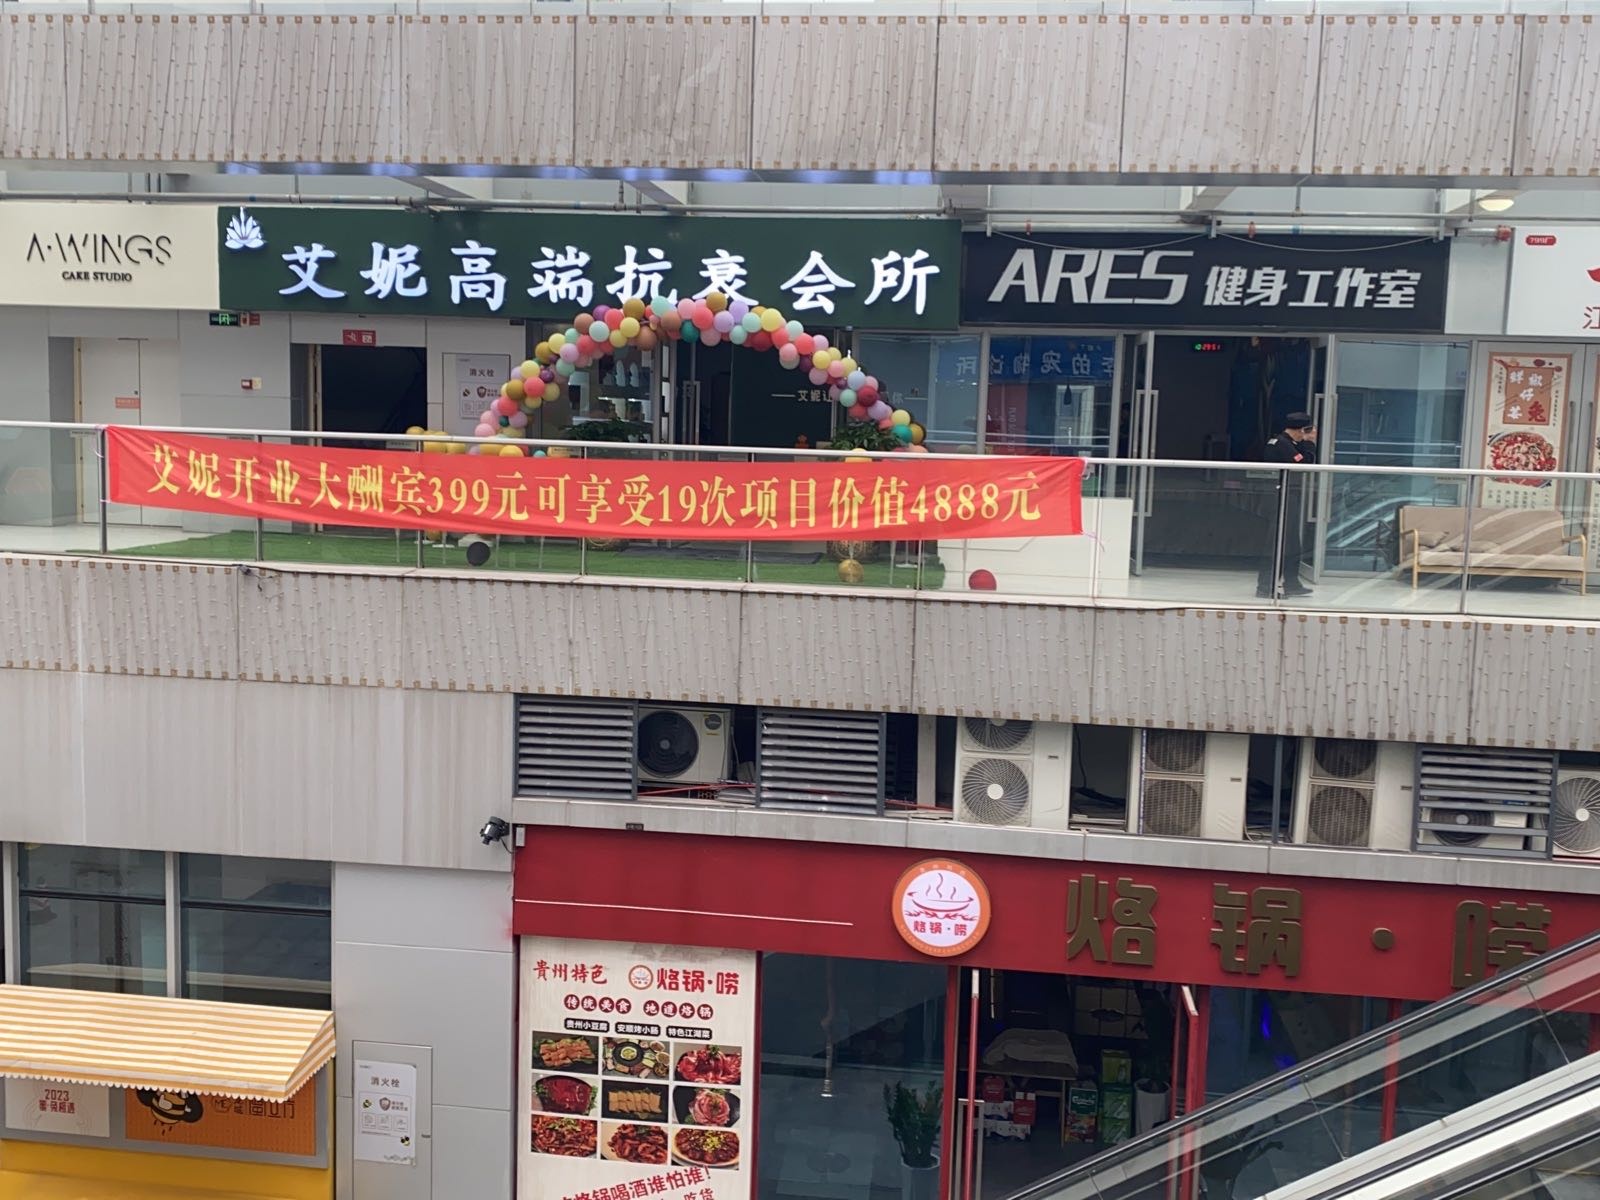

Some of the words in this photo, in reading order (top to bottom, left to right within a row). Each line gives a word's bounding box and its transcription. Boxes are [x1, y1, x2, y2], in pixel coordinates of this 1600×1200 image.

[62, 271, 90, 281] CAKE
[92, 271, 132, 282] STUDIO
[278, 239, 940, 316] 艾妮高端抗衰会所
[988, 248, 1194, 305] ARES
[1203, 265, 1421, 310] 健身工作室
[469, 368, 494, 377] 消火栓
[147, 444, 1041, 529] 艾妮开业大酬宾399元可享受19次项目价值4888元
[565, 995, 632, 1013] 传统美食
[644, 1001, 713, 1020] 地道烙锅
[370, 1076, 400, 1088] 消火栓
[44, 1089, 70, 1102] 2023
